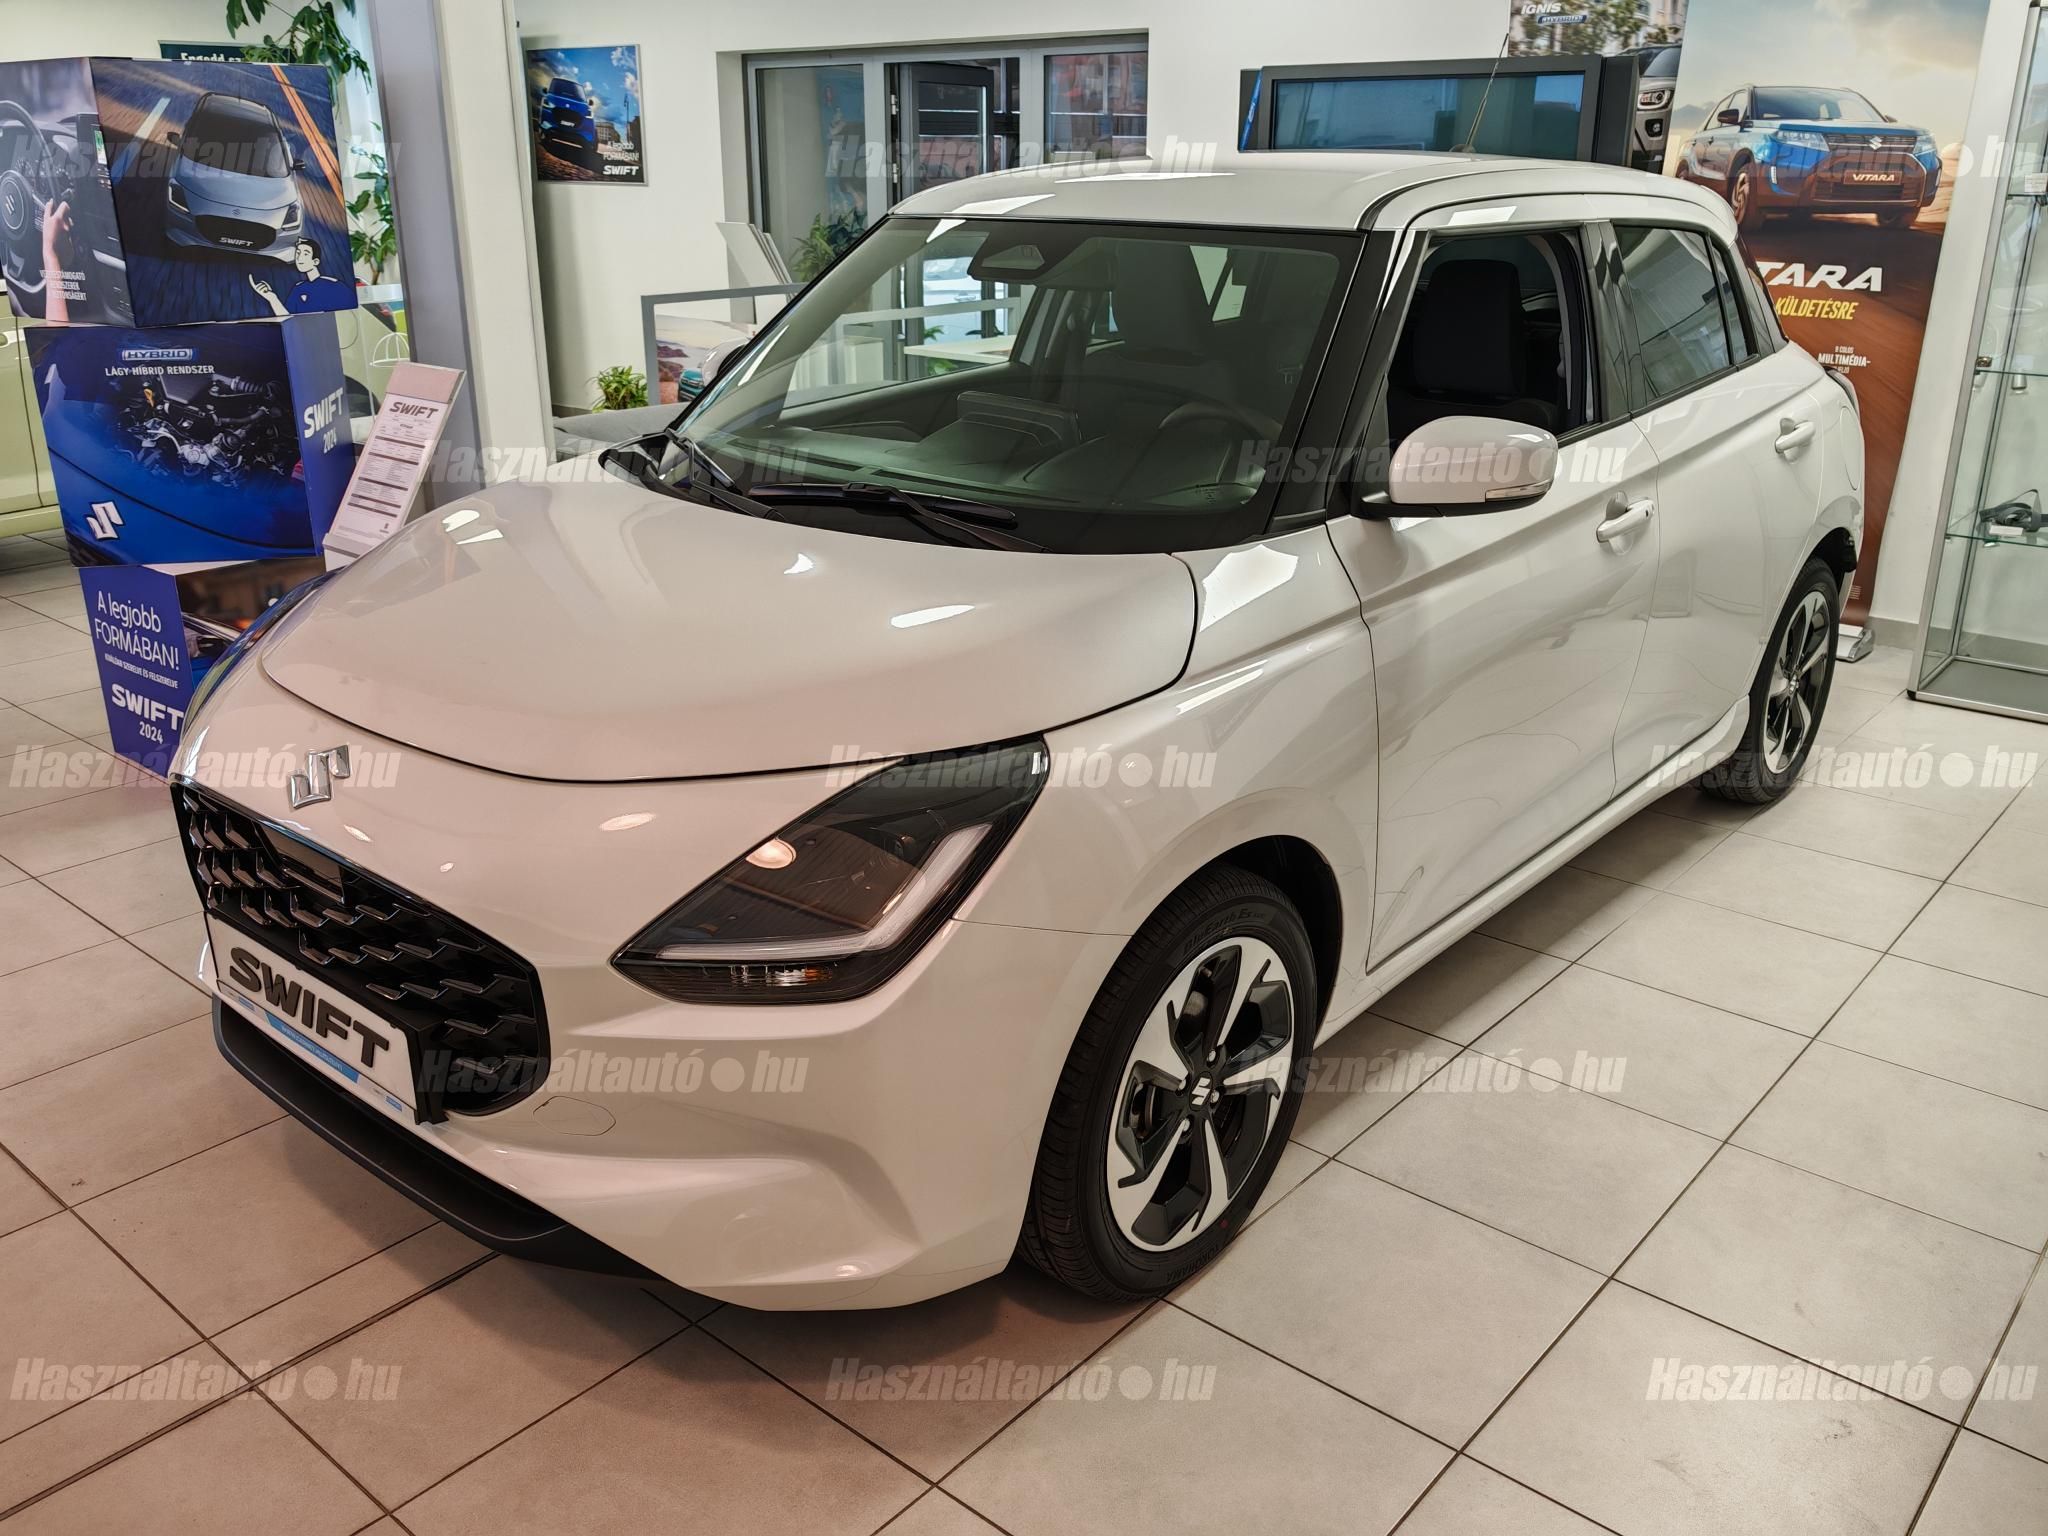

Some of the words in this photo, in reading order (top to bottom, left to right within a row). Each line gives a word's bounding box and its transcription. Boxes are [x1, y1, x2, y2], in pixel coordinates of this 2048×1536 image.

[1521, 3, 1561, 14] IGNIS
[603, 165, 639, 175] SWIFT
[1853, 173, 1895, 182] VITARA
[220, 237, 254, 247] SWIFT
[1756, 260, 1883, 292] TARA
[1775, 295, 1859, 320] KÜLDETÉSRE
[127, 349, 188, 359] HYBRID
[105, 365, 129, 376] LÁGY
[167, 365, 215, 375] RENDSZER
[304, 387, 344, 439] SWIFT
[389, 402, 439, 419] SWIFT
[323, 427, 337, 454] 2024
[98, 590, 107, 615] A
[108, 592, 162, 633] legjobb
[94, 618, 180, 671] FORMÁBAN!
[111, 683, 184, 731] SWIFT
[139, 721, 164, 744] 2024
[229, 947, 390, 1069] SWIFT
